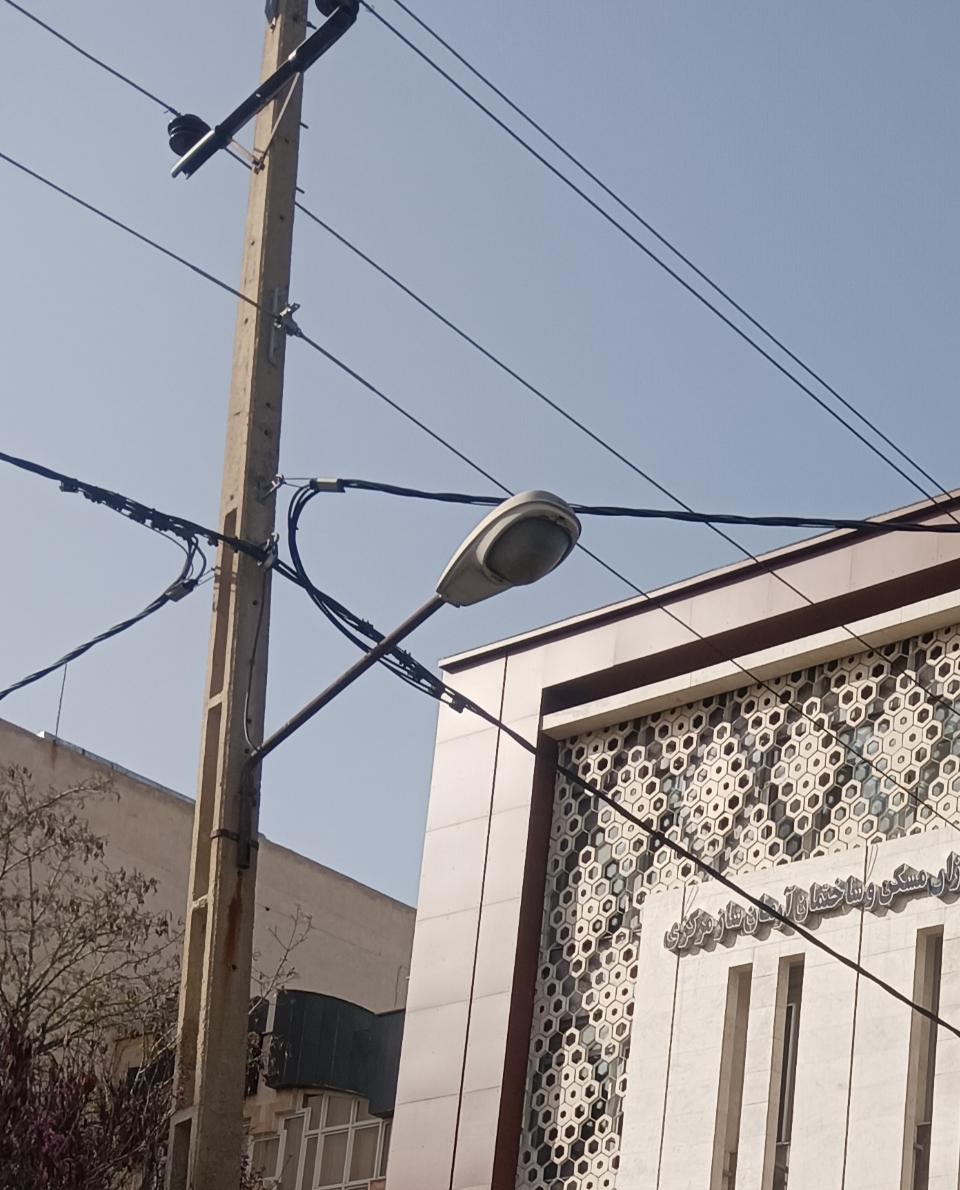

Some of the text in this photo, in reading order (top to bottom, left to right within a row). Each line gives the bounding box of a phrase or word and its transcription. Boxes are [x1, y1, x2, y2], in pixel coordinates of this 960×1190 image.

[794, 875, 865, 923] ساختمان
[864, 882, 877, 910] و
[879, 863, 927, 906] مسکن
[665, 911, 715, 951] مرکزی
[714, 900, 745, 940] ساز
